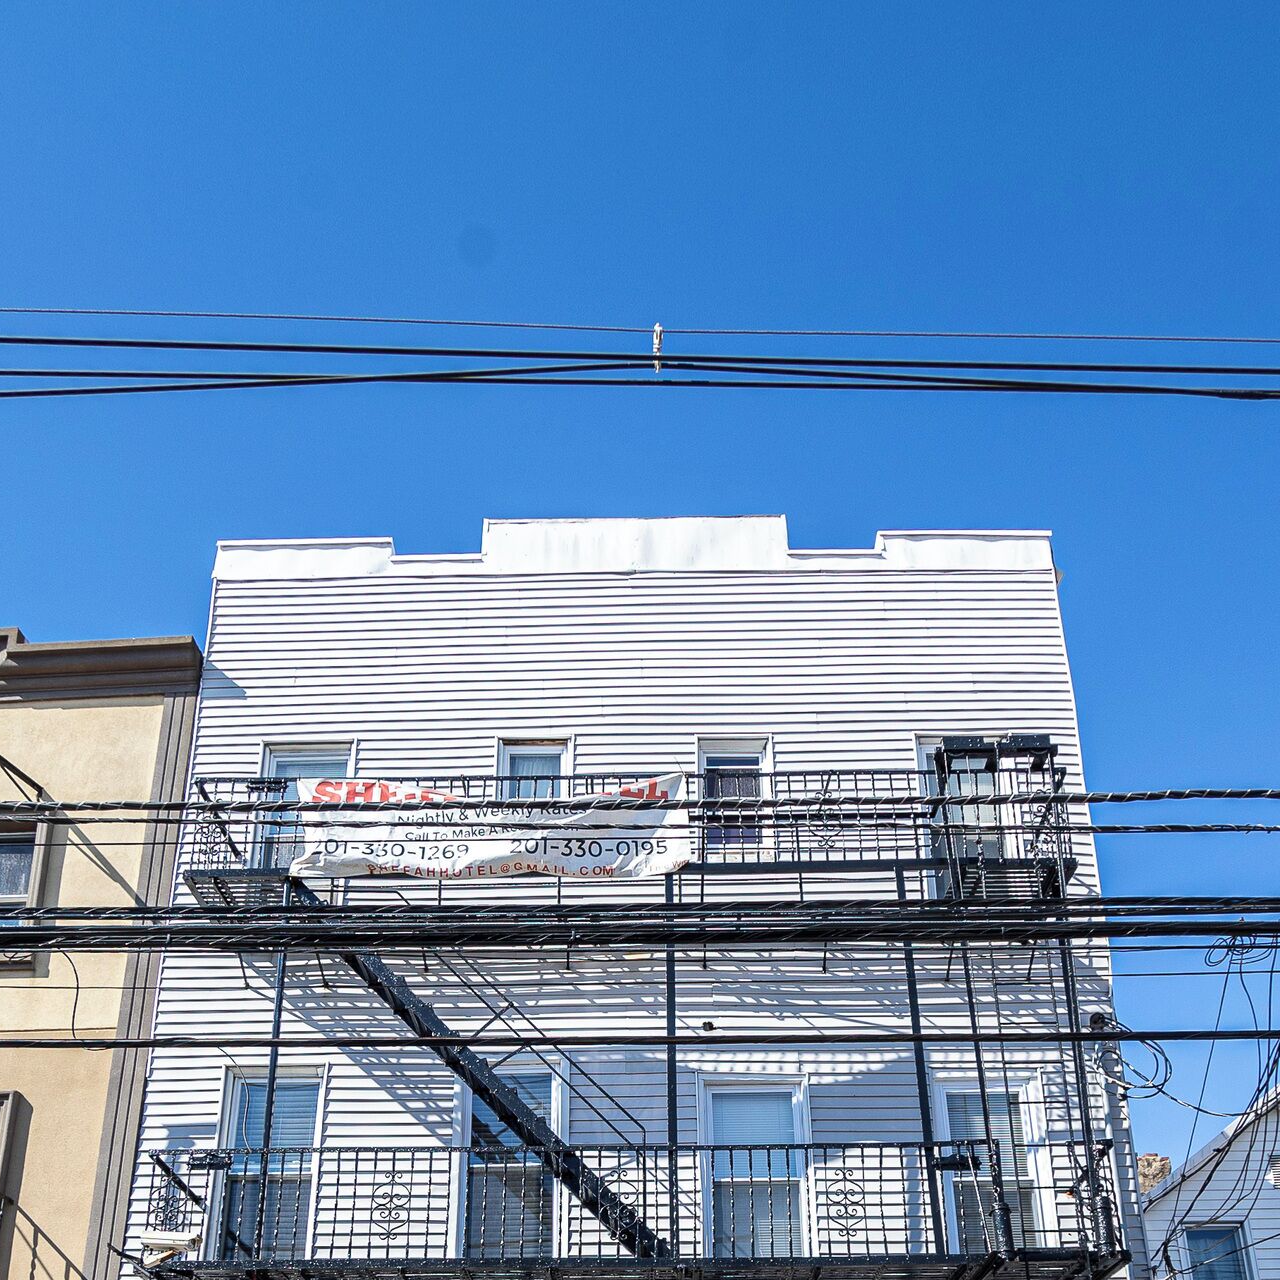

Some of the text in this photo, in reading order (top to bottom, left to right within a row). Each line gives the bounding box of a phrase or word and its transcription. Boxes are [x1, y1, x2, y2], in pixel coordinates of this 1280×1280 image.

[459, 807, 469, 821] &
[453, 826, 485, 838] Make
[509, 838, 668, 858] 201-330-0195
